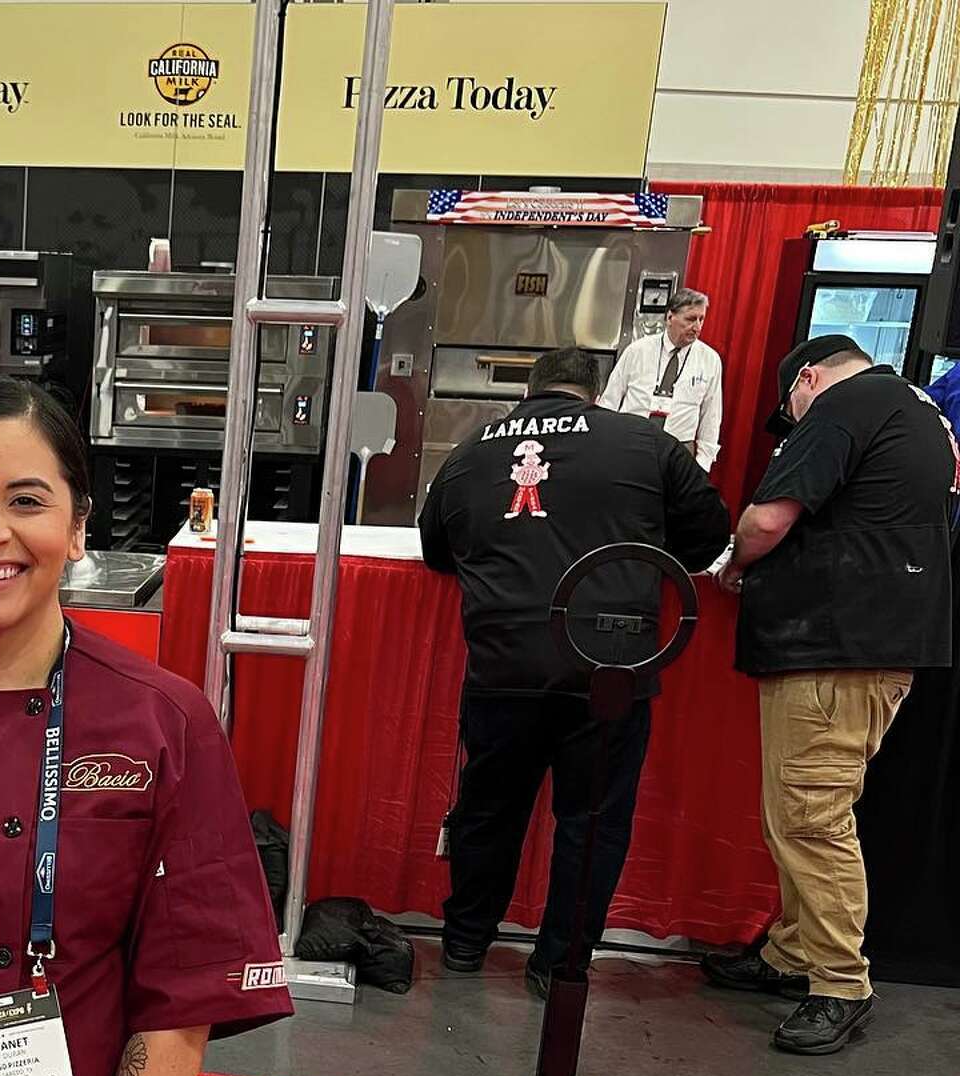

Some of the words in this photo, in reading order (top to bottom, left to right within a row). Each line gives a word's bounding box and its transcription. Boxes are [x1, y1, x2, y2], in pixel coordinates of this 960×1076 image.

[150, 60, 217, 77] CALIFORNIA
[166, 77, 200, 87] MILK
[342, 76, 440, 110] Pzza
[446, 76, 558, 121] Today
[120, 112, 152, 127] LOOK
[154, 112, 179, 127] FOR
[183, 113, 205, 128] THE
[493, 210, 584, 223] INDEPENDENT'S
[586, 212, 609, 223] DAY
[480, 415, 590, 442] LAMARCA
[40, 726, 61, 822] BELLISSIMO
[65, 761, 142, 788] Bacio
[8, 1057, 40, 1069] PIZZERIA
